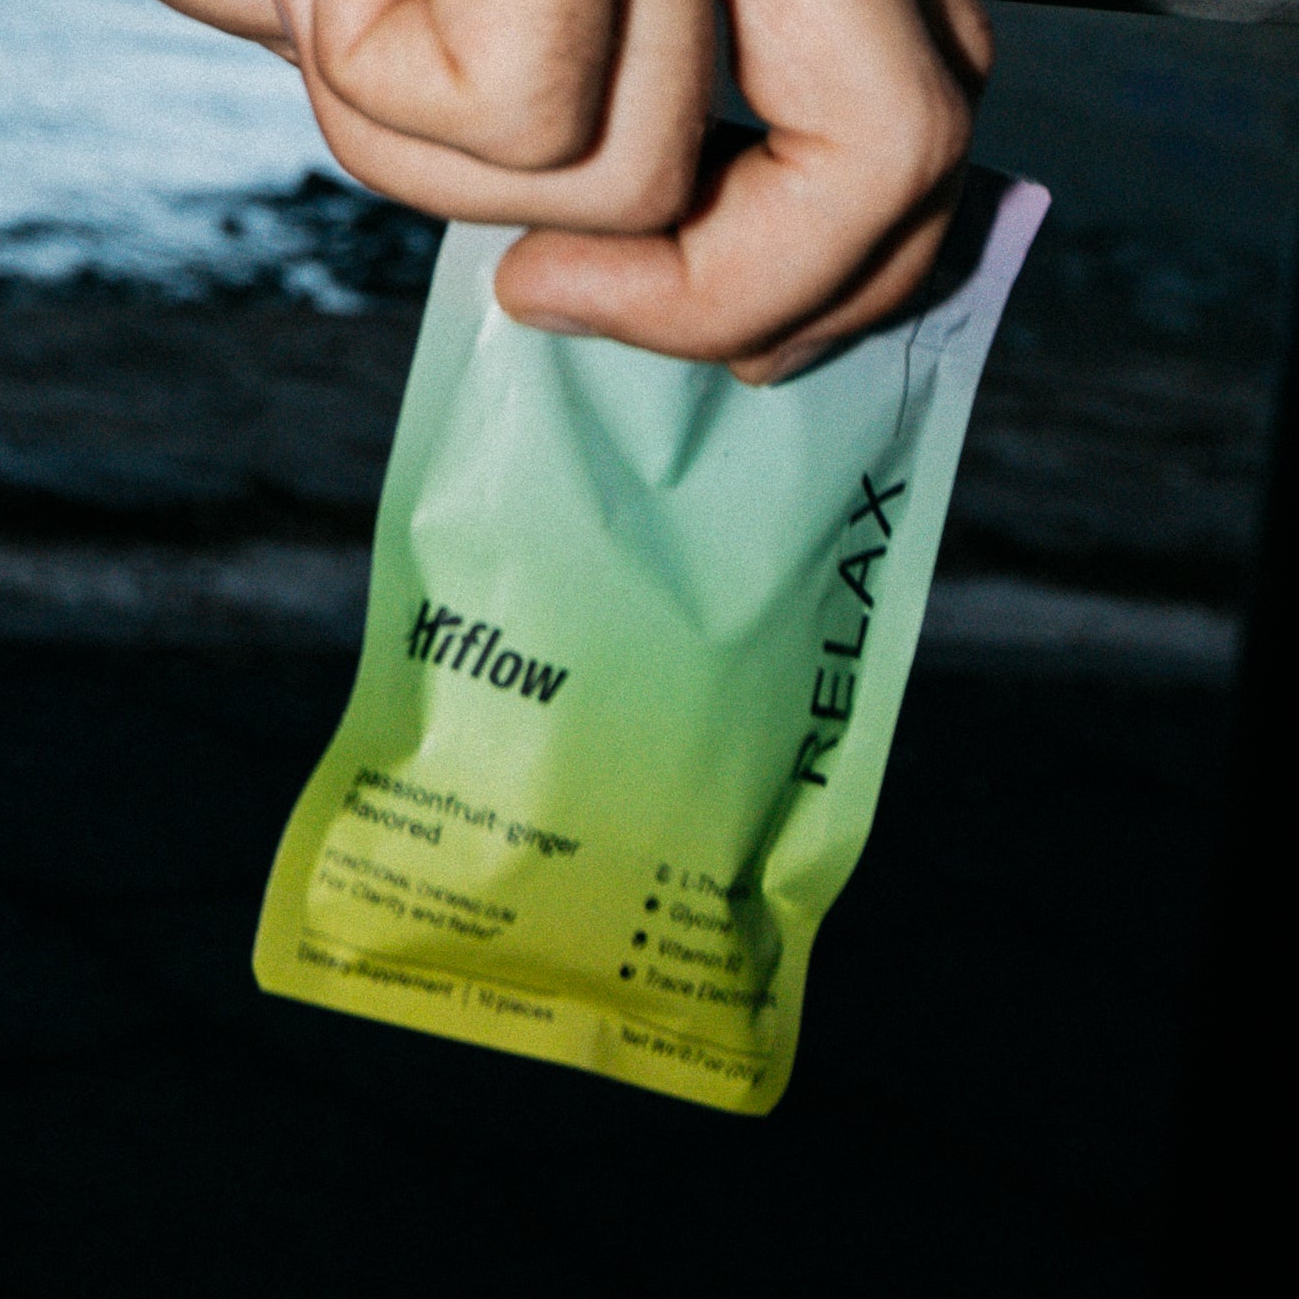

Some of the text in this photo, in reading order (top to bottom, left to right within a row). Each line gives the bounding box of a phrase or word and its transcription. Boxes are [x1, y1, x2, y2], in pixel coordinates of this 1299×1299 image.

[408, 598, 569, 704] Hiflow
[790, 471, 907, 787] RELAX
[344, 789, 443, 846] flavored
